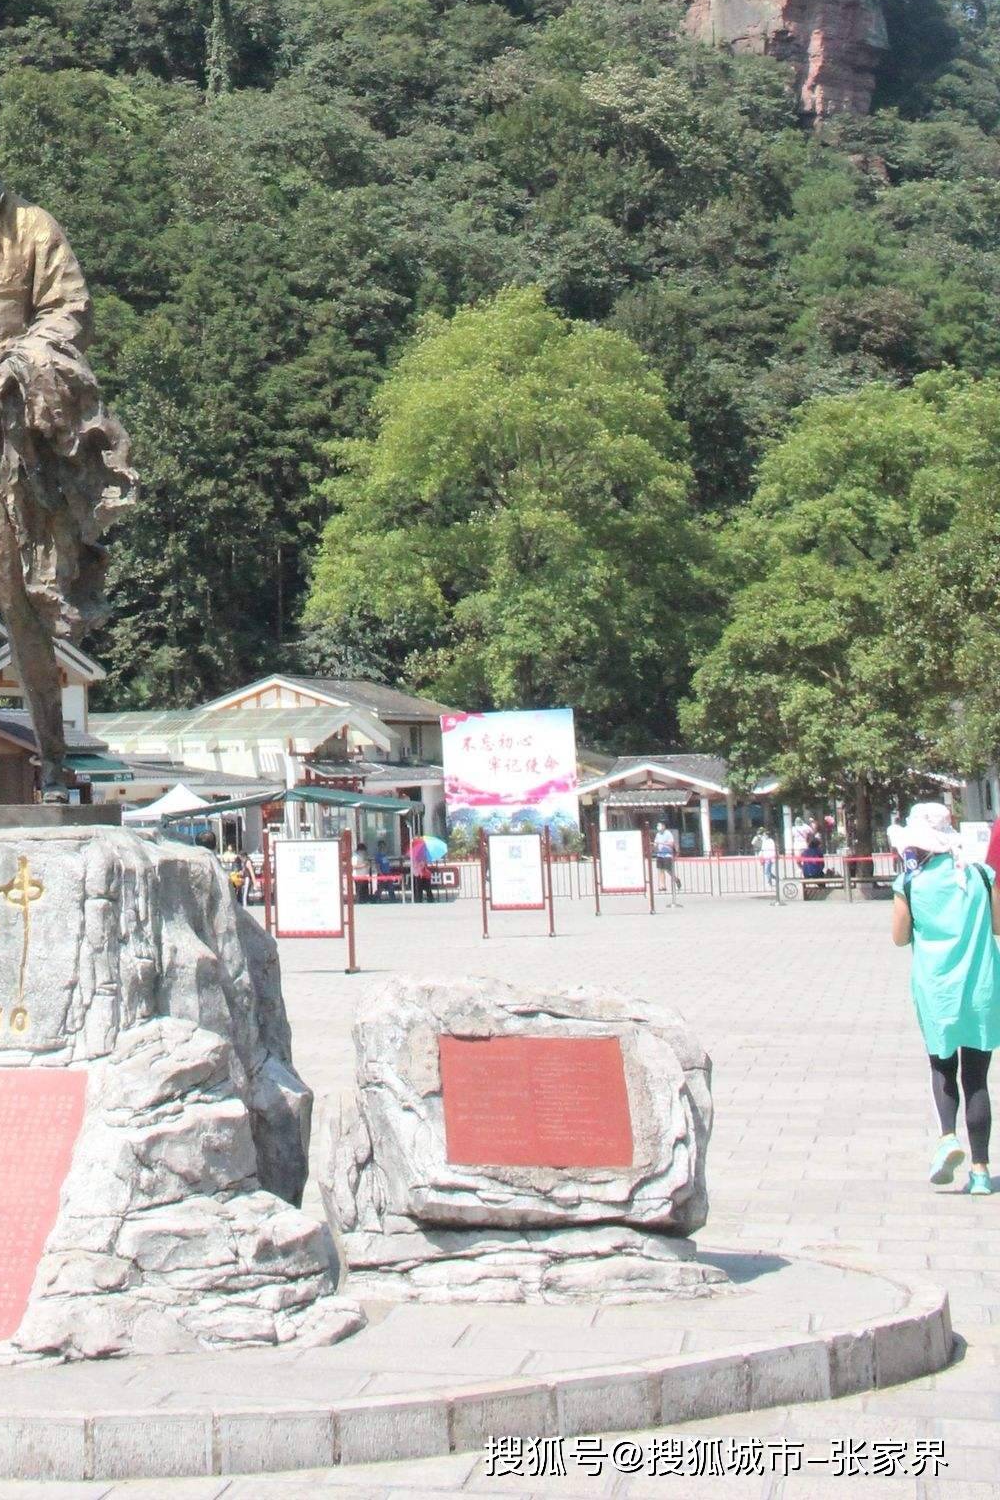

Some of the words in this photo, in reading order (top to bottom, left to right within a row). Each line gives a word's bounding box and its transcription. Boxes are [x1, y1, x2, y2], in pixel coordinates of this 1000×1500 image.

[463, 733, 533, 752] 不忘初心
[488, 755, 560, 776] 牢记使命
[430, 871, 455, 885] 出口
